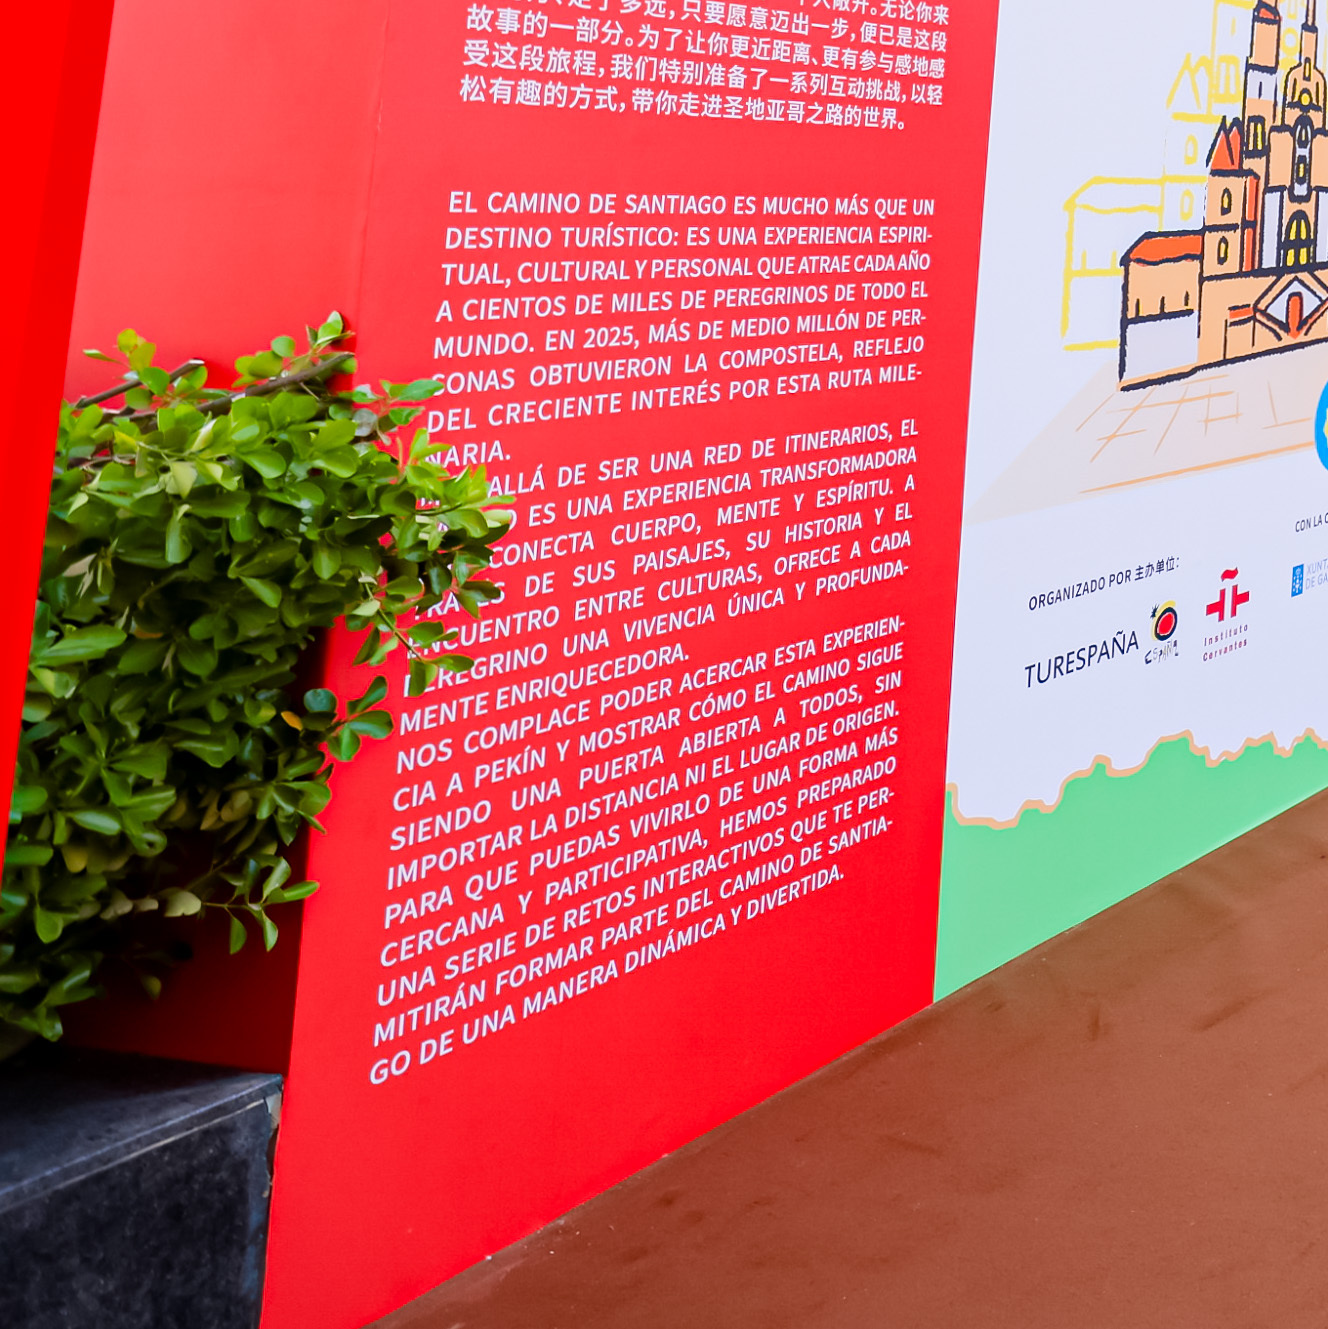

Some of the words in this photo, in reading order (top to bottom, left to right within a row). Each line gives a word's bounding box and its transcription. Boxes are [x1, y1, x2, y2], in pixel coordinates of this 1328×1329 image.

[448, 191, 478, 214] EL
[487, 191, 581, 214] CAMINO
[588, 193, 617, 214] DE
[624, 194, 727, 215] SANTIAGO
[733, 196, 757, 215] ES
[762, 196, 829, 216] MUCHO
[834, 192, 869, 216] MÁS
[874, 198, 908, 220] QUE
[912, 198, 935, 216] UN
[445, 226, 552, 250] DESTINO
[560, 221, 679, 248] TURÍSTICO:
[686, 226, 711, 246] ES
[717, 226, 758, 246] UNA
[763, 226, 873, 246] EXPERIENCIA
[878, 226, 933, 244] ESPIRI-
[441, 262, 512, 289] TUAL,
[517, 259, 631, 284] CULTURAL
[634, 259, 648, 279] Y
[650, 257, 754, 279] PERSONAL
[757, 256, 796, 280] QUE
[797, 254, 851, 274] ATRAE
[853, 254, 896, 273] CADA
[896, 249, 931, 271] AÑO
[435, 299, 453, 323] A
[462, 295, 567, 321] CIENTOS
[574, 293, 604, 316] DE
[611, 291, 673, 313] MILES
[680, 289, 707, 310] DE
[713, 284, 829, 308] PEREGRINOS
[834, 283, 857, 302] DE
[861, 281, 906, 301] TODO
[910, 280, 929, 299] EL
[433, 331, 535, 359] MUNDO.
[545, 328, 575, 352] EN
[582, 325, 640, 350] 2025,
[648, 317, 691, 344] MÁS
[697, 320, 724, 341] DE
[730, 316, 791, 338] MEDIO
[796, 308, 860, 334] MILLÓN
[865, 310, 887, 329] DE
[891, 308, 927, 327] PER-
[1295, 518, 1312, 533] CON
[1313, 514, 1323, 527] LA
[1028, 576, 1106, 611] ORGANIZADO
[1108, 569, 1132, 588] POR
[1134, 555, 1180, 582] 主办单位：
[1305, 576, 1315, 590] DE
[1202, 638, 1248, 662] Cervantes
[1203, 624, 1249, 647] Instituto
[1024, 630, 1139, 688] TURESPAÑA
[377, 965, 436, 1007] UNA
[443, 931, 518, 981] SERIE
[524, 915, 556, 949] DE
[563, 885, 636, 933] RETOS
[643, 826, 785, 900] INTERACTIVOS
[789, 810, 828, 843] QUE
[832, 799, 854, 824] TE
[857, 786, 895, 815] PER-
[373, 979, 486, 1048] MITIRÁN
[495, 935, 594, 996] FORMAR
[601, 903, 669, 951] PARTE
[675, 887, 714, 919] DEL
[719, 853, 795, 900] CAMINO
[799, 840, 823, 867] DE
[827, 815, 893, 855] SANTIA-
[369, 1049, 411, 1085] GO
[419, 1028, 455, 1065] DE
[462, 1004, 516, 1045] UNA
[522, 959, 619, 1019] MANERA
[624, 912, 726, 974] DINÁMICA
[730, 904, 743, 926] Y
[746, 863, 845, 920] DIVERTIDA.
